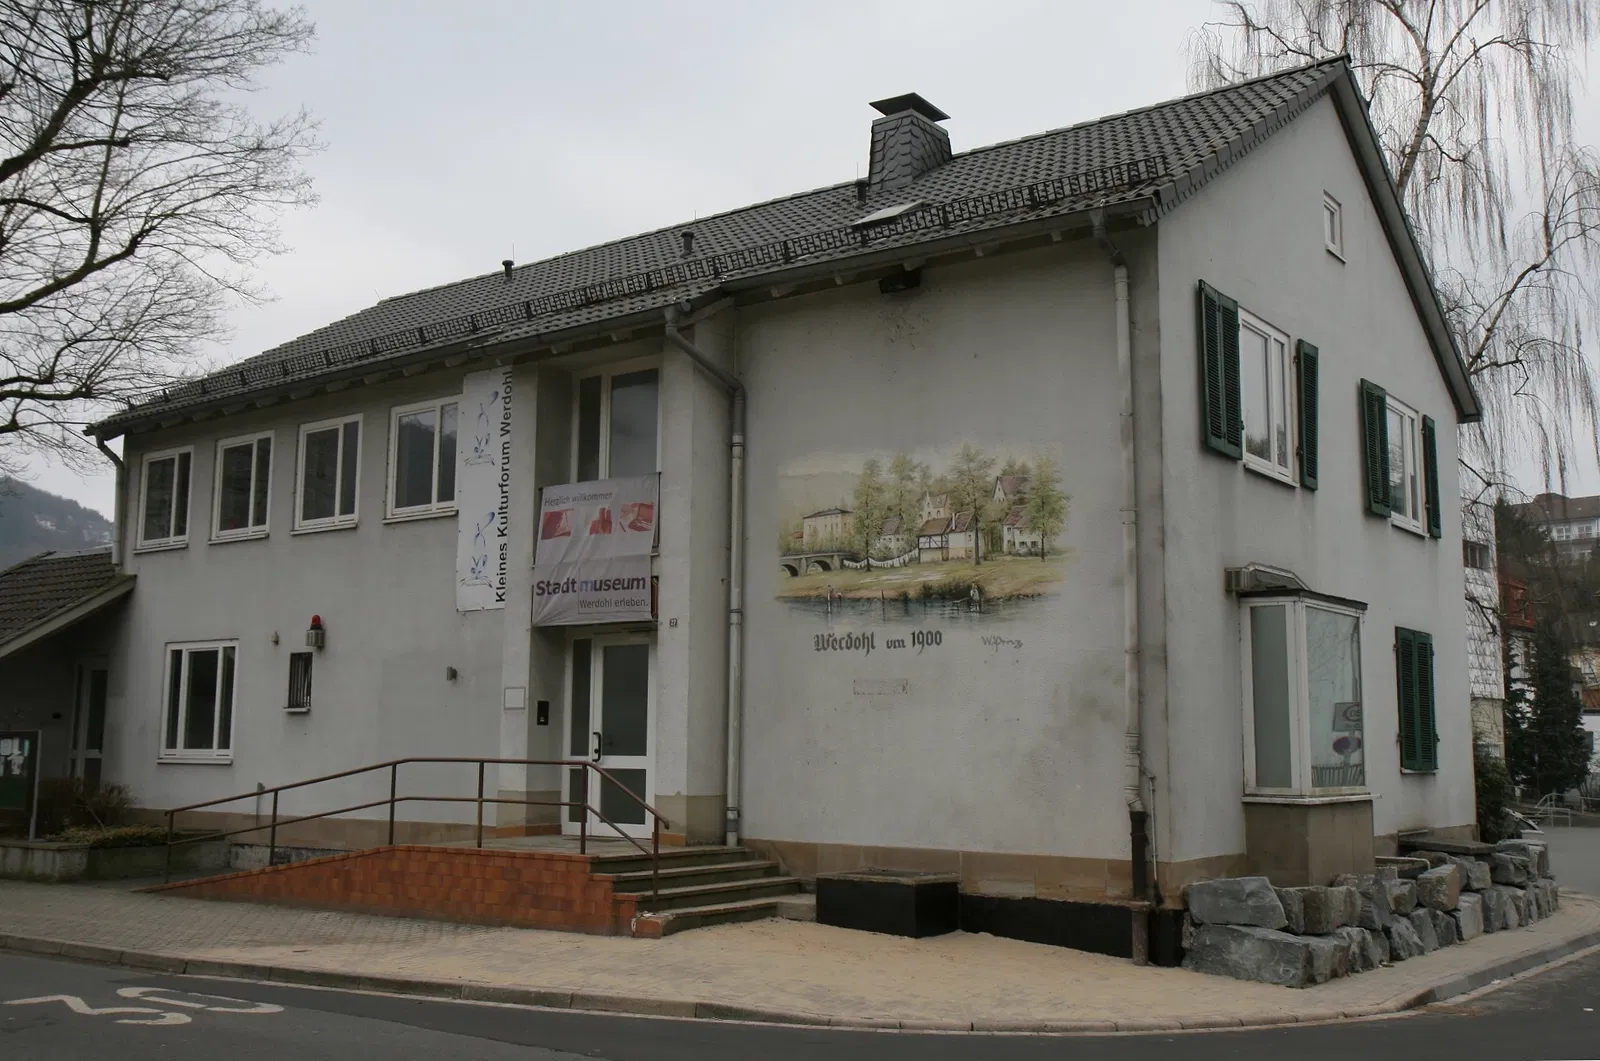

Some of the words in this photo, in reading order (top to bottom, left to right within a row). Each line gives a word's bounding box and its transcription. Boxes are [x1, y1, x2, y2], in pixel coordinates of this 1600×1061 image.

[500, 370, 513, 438] Werdohl
[497, 441, 511, 538] Kulturforum
[544, 495, 570, 507] Herzlich
[572, 491, 613, 503] willkommen
[495, 542, 508, 603] Kleines
[579, 598, 612, 609] Werdohl
[614, 597, 649, 607] erleben.
[813, 631, 876, 657] Werdohl
[910, 630, 943, 656] 1900
